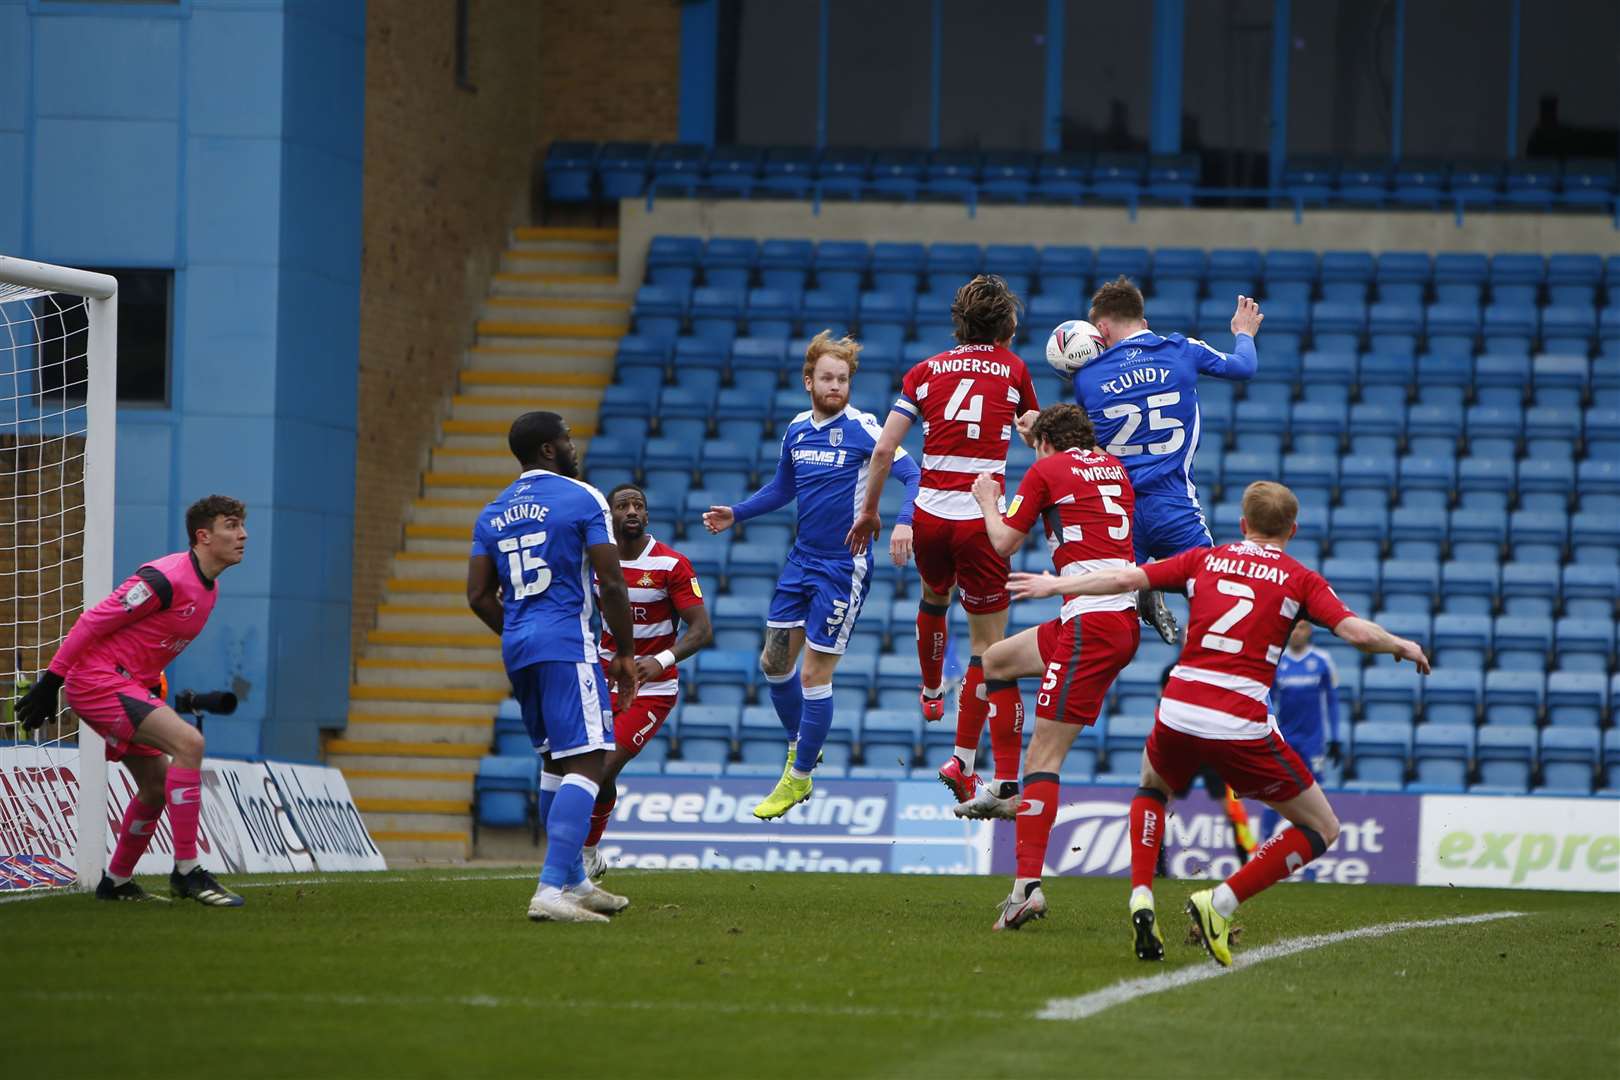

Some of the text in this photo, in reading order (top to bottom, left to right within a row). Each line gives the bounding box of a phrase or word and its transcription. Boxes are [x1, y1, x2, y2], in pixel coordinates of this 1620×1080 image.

[932, 358, 1011, 379] ANDERSON
[1110, 367, 1170, 394] CUNDY
[944, 378, 984, 440] 4
[1103, 391, 1186, 457] 25
[495, 503, 550, 532] AKINDE
[1097, 484, 1130, 541] 5
[498, 531, 552, 601] 15
[1206, 556, 1290, 586] HALLIDAY
[826, 599, 848, 625] 3
[1201, 578, 1256, 654] 2
[1042, 661, 1062, 691] 5
[1436, 830, 1620, 885] expre
